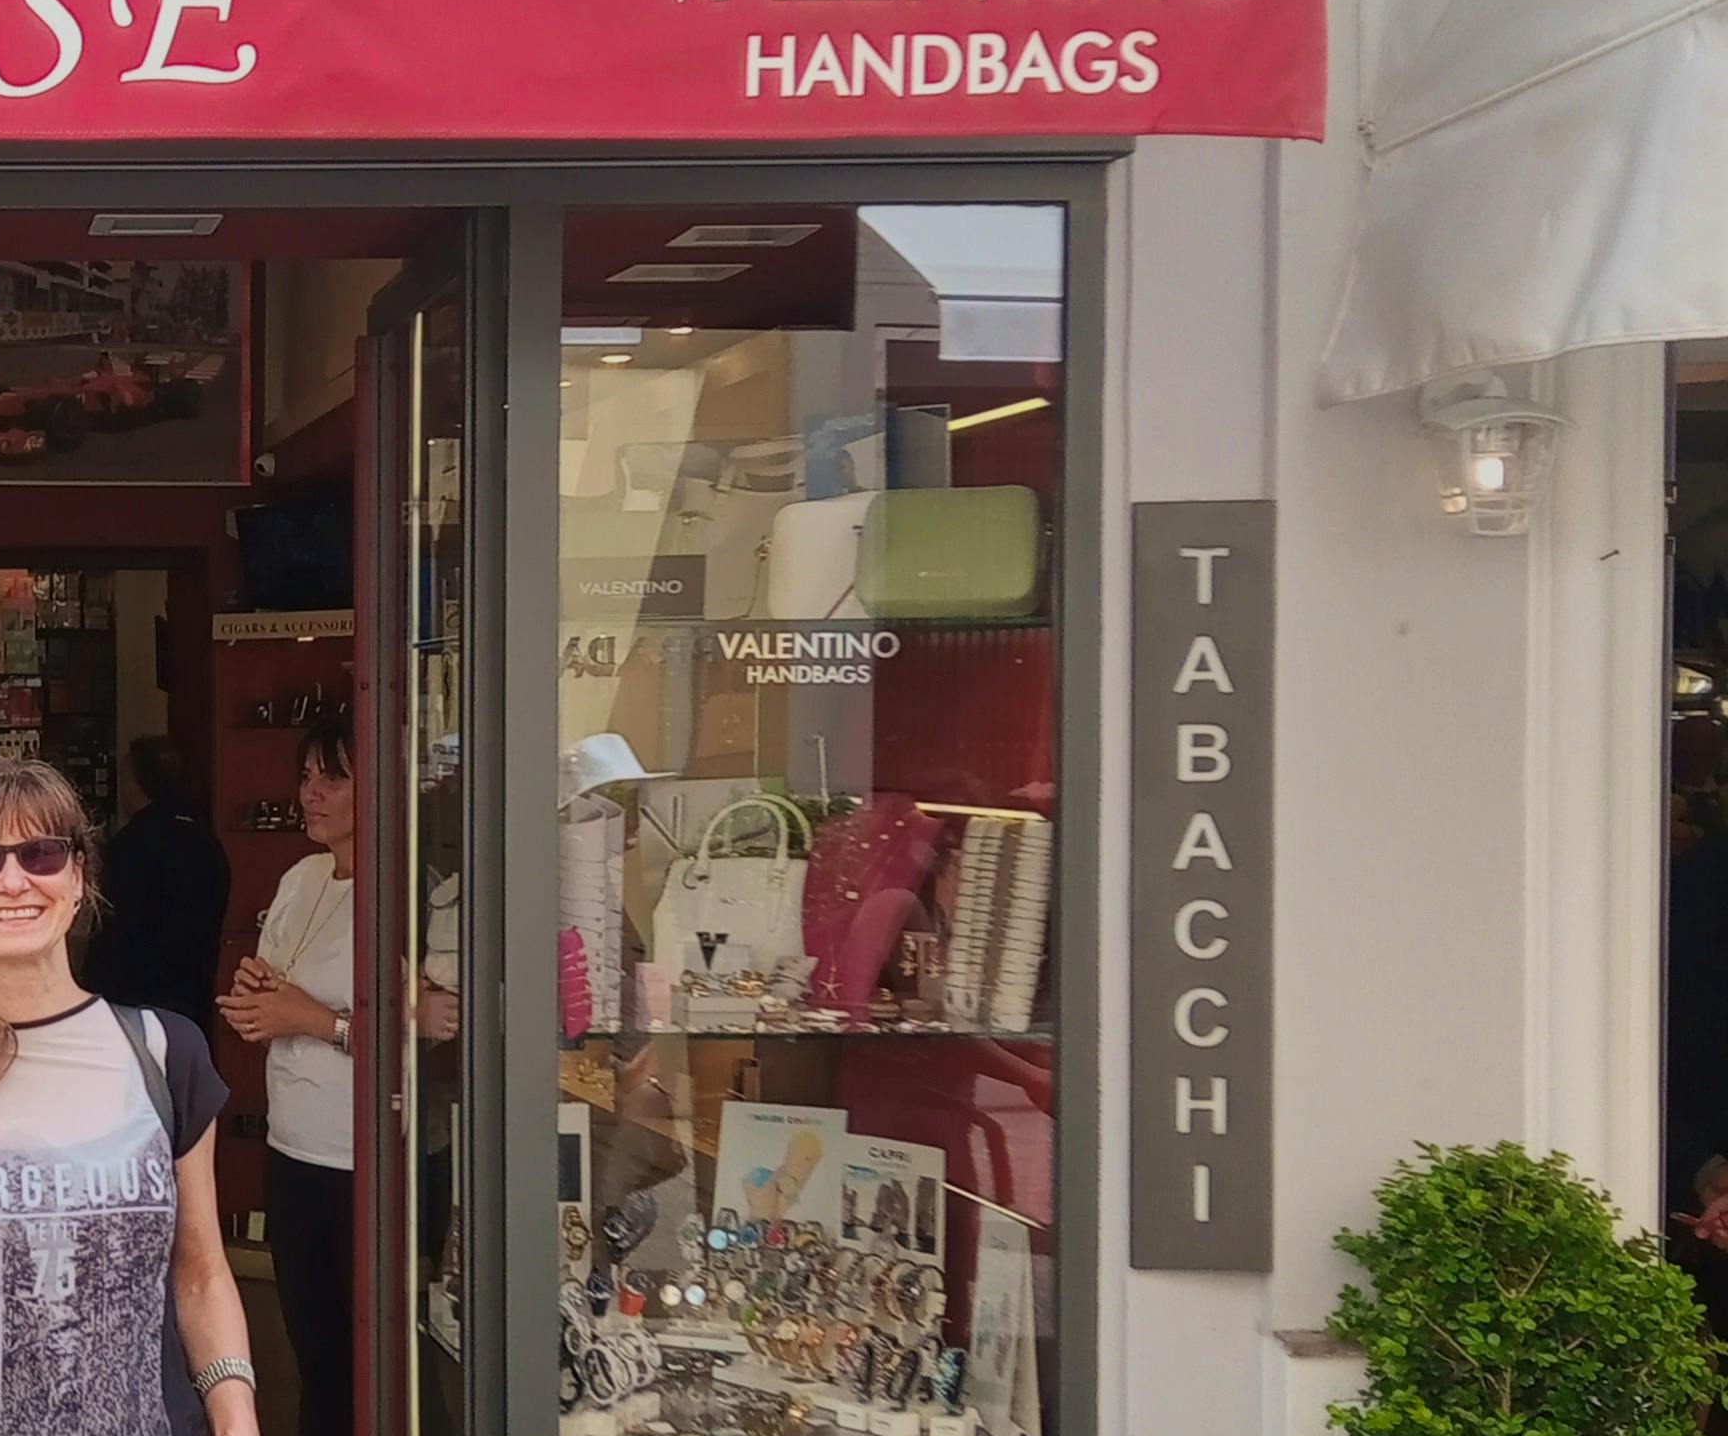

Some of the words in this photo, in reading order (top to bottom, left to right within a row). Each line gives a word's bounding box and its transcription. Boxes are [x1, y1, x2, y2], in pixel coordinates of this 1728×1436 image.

[744, 29, 1160, 99] HANDBAGS
[577, 579, 684, 597] VALENTINO
[717, 631, 902, 660] VALENTINO
[745, 663, 872, 685] HANDBAGS
[1172, 547, 1234, 1222] TABACCHI
